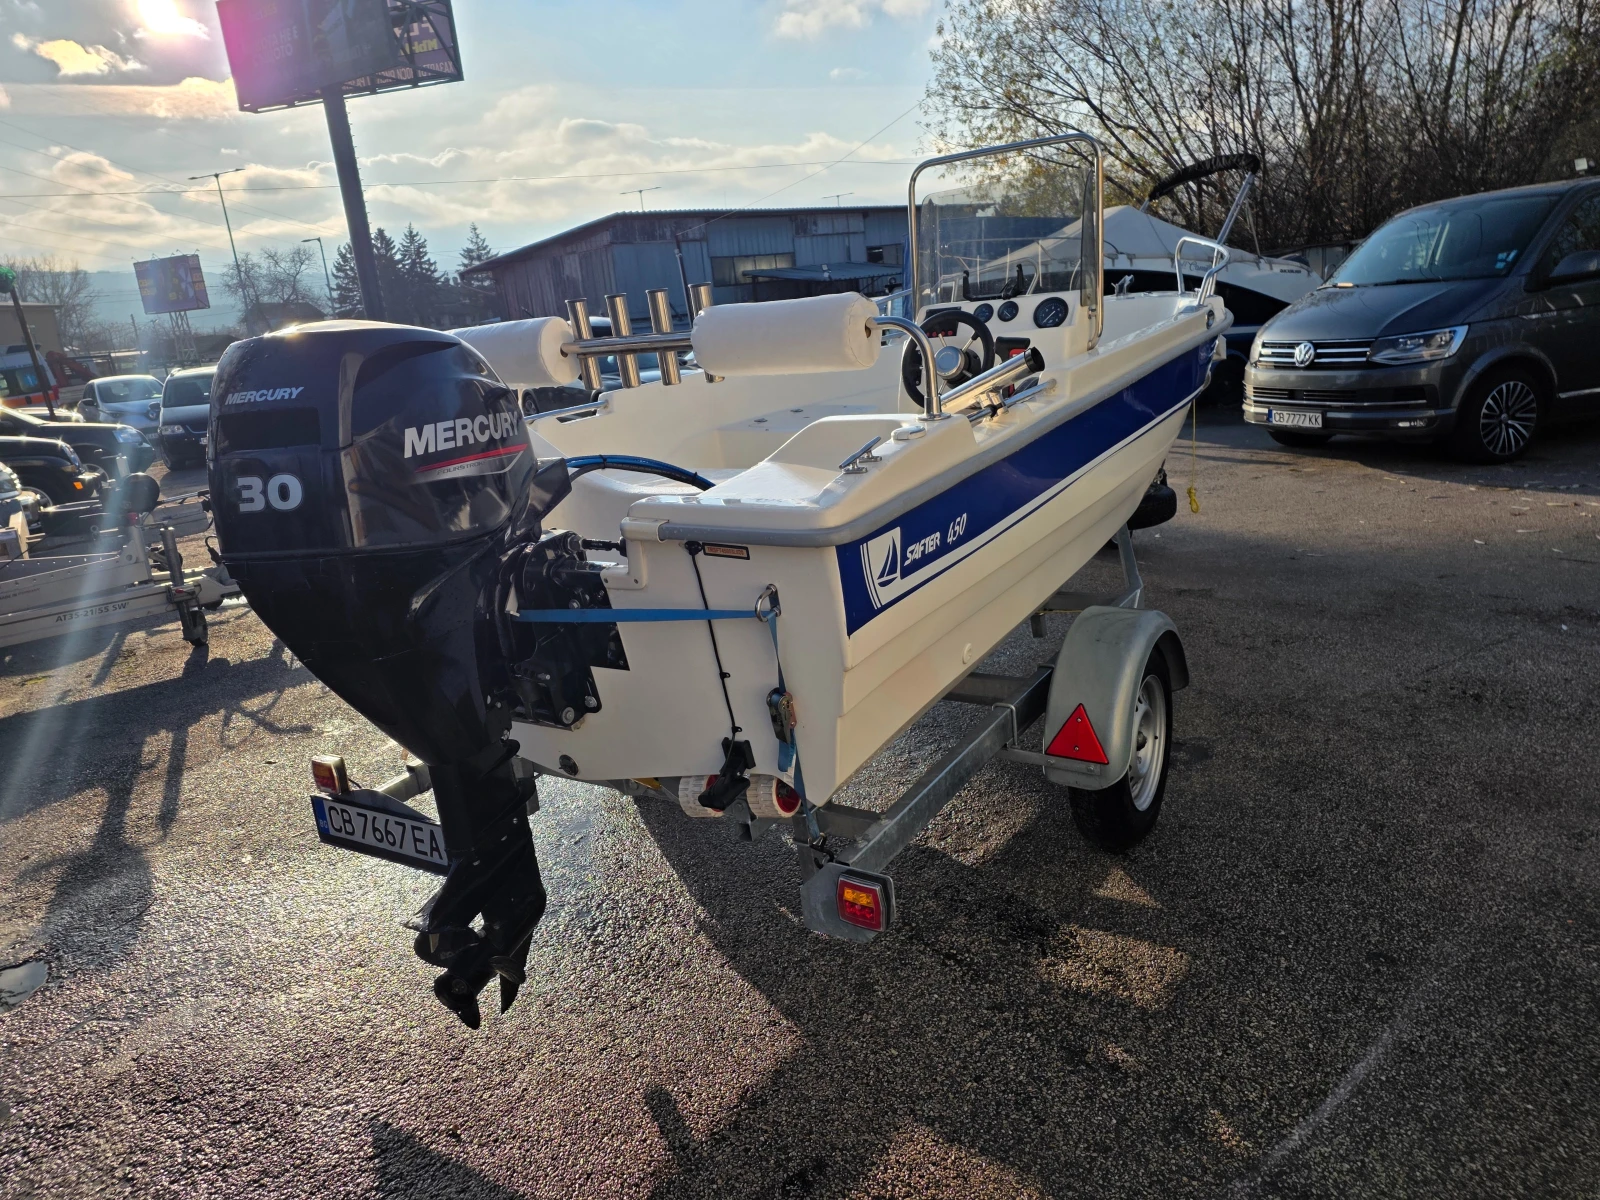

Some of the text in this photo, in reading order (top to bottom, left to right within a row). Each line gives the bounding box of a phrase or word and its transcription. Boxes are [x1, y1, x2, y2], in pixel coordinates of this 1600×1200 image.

[225, 386, 305, 405] MERCURY
[404, 411, 519, 459] MERCURY
[1285, 412, 1307, 425] 7777
[237, 474, 303, 512] 30
[904, 512, 967, 567] SAFTER 450
[356, 812, 406, 849] 7667
[411, 825, 443, 860] EA
